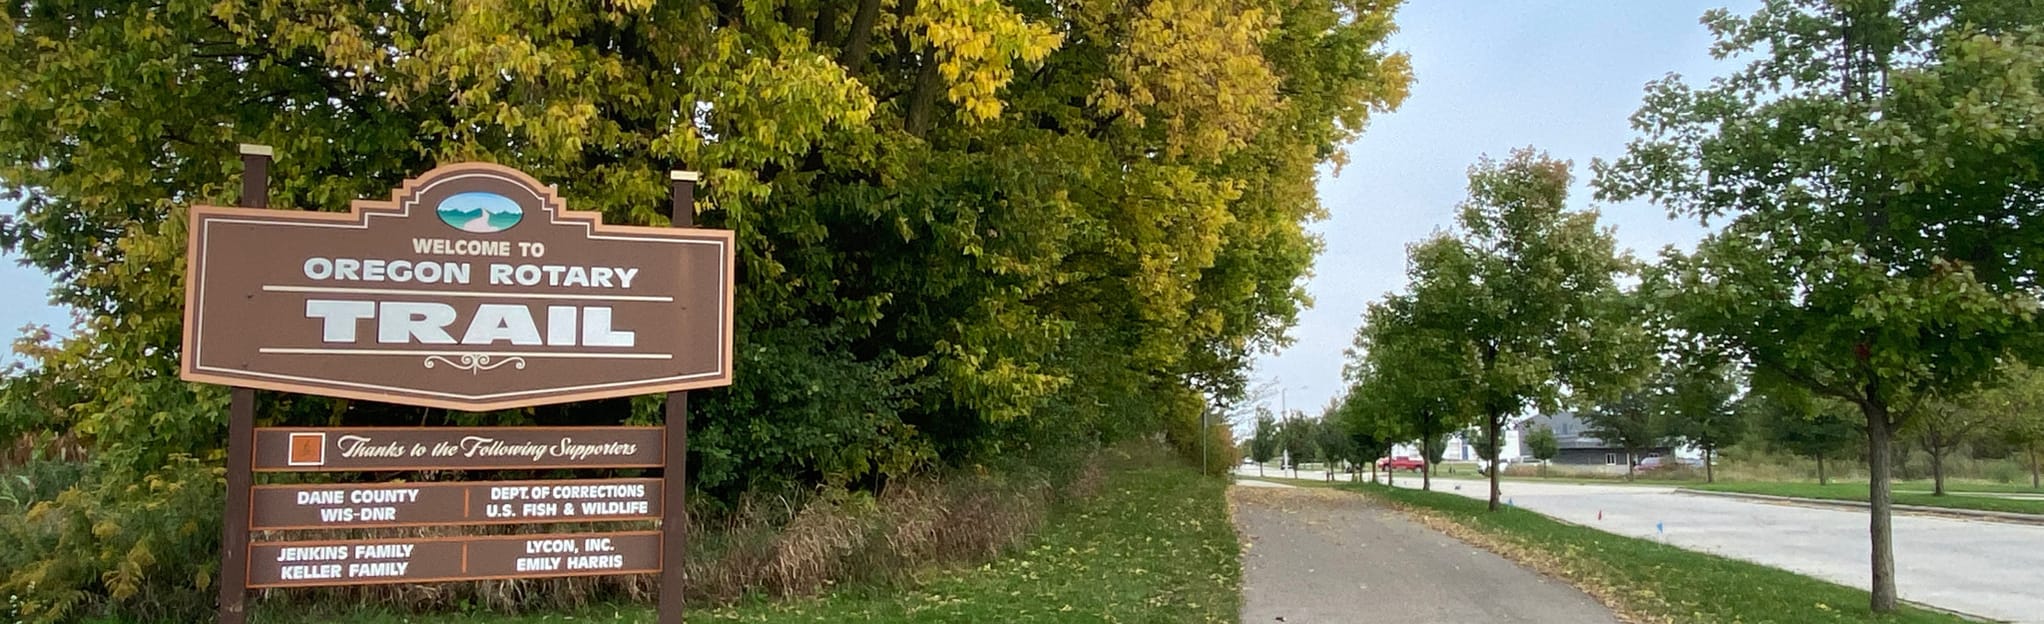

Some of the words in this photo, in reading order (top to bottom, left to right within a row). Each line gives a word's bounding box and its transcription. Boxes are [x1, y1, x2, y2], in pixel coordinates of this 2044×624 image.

[413, 237, 510, 257] WELCOME
[519, 242, 545, 257] TO
[304, 257, 470, 284] OREGON
[489, 263, 638, 289] ROTARY
[305, 299, 635, 347] TRAIL
[337, 435, 405, 458] Thanks
[410, 443, 427, 457] to
[431, 441, 458, 457] the
[460, 435, 547, 462] Following
[550, 437, 637, 459] Supporters
[297, 490, 344, 504] DANE
[351, 488, 419, 504] COUNTY
[491, 486, 529, 500] DEPT.
[532, 486, 550, 500] OF
[553, 485, 645, 499] CORRECTIONS
[320, 507, 396, 522] WIS-DNR
[486, 503, 516, 518] U.S.
[523, 503, 557, 516] FISH
[563, 502, 574, 515] &
[582, 500, 648, 515] WILDLIFE
[277, 546, 348, 562] JENKINS
[355, 544, 414, 560] FAMILY
[526, 539, 579, 555] LYCON,
[585, 538, 614, 552] INC.
[281, 564, 341, 579] KELLER
[349, 562, 407, 578] FAMILY
[516, 557, 560, 572] EMILY
[567, 555, 623, 569] HARRIS
